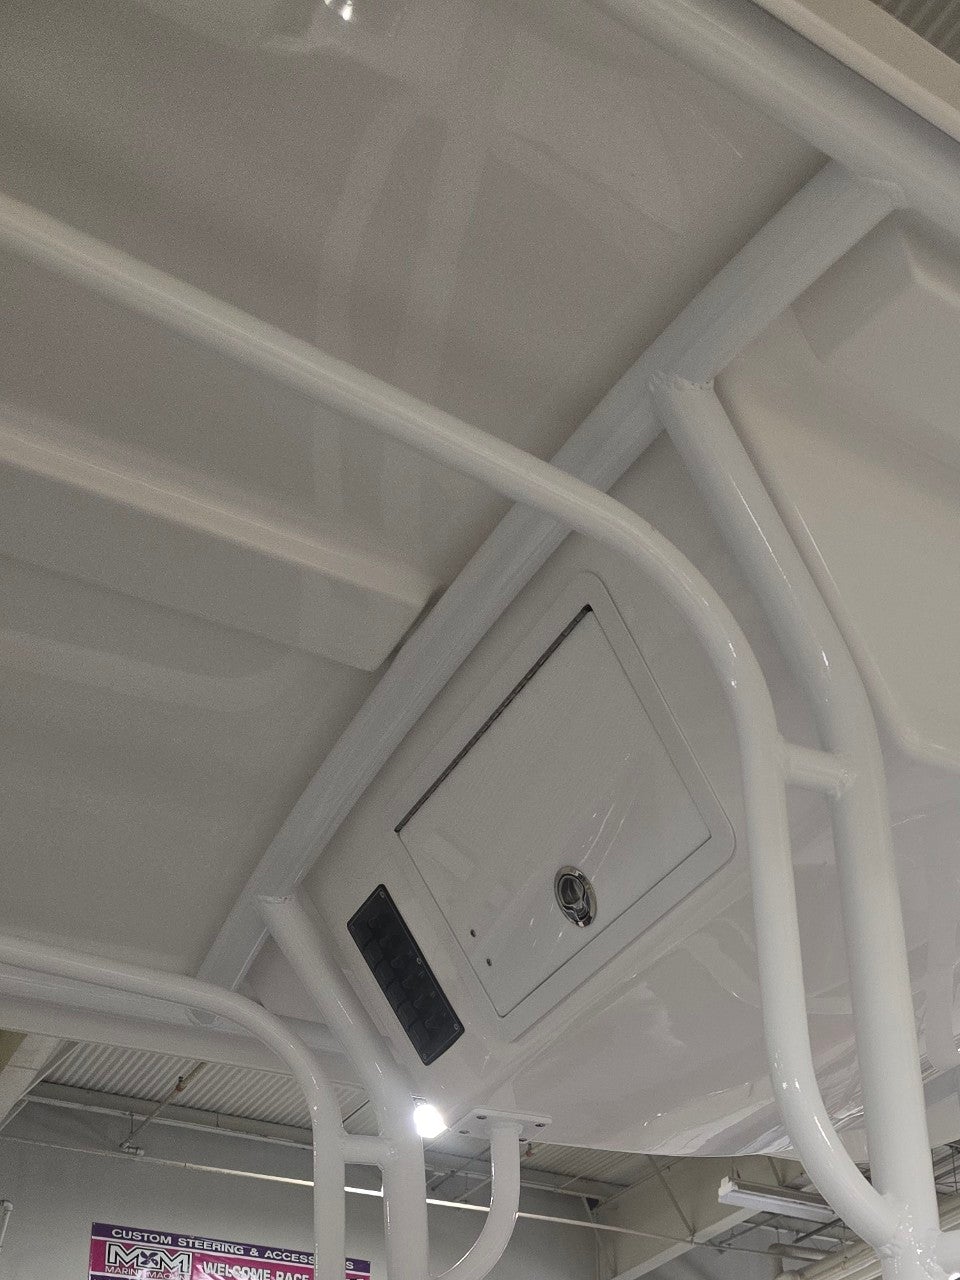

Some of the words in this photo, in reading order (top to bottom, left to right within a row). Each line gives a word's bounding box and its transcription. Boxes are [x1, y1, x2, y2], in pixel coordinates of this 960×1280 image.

[112, 1229, 172, 1244] CUSTOM
[178, 1238, 244, 1254] STEERING
[250, 1247, 259, 1257] &
[264, 1250, 354, 1269] ACCESSS
[105, 1266, 144, 1277] MARIN
